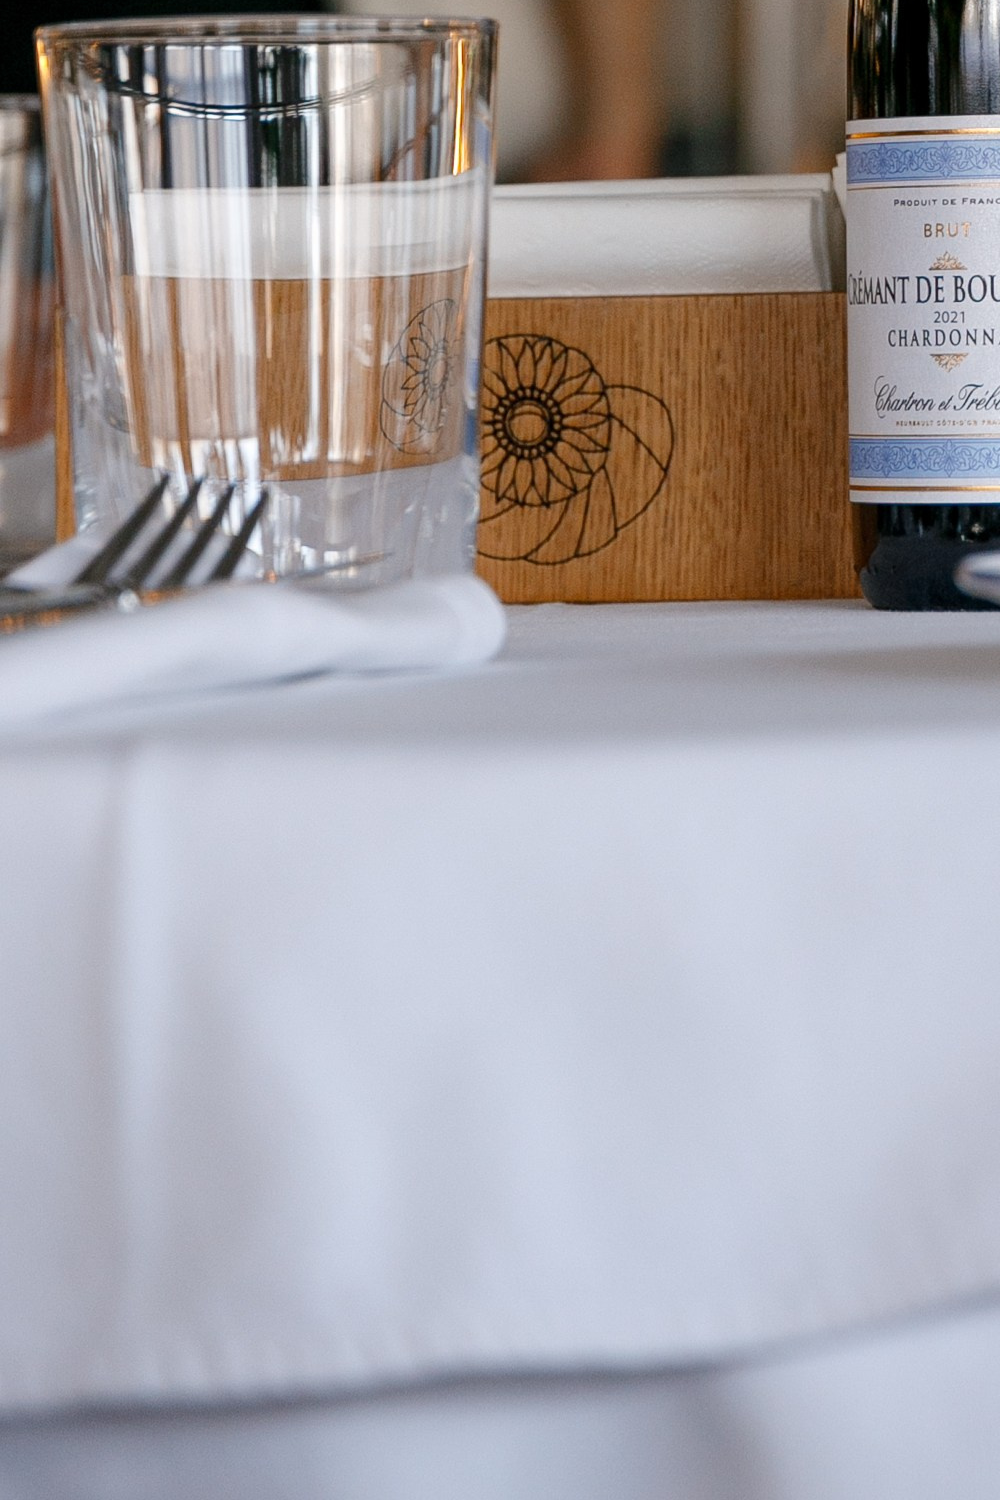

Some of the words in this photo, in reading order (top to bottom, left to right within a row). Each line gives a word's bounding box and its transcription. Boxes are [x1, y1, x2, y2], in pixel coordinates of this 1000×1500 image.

[893, 198, 938, 207] PRODUIT
[942, 198, 956, 206] DE
[923, 222, 972, 238] BRUT
[848, 270, 910, 306] CRÉMANT
[915, 275, 945, 304] DE
[933, 311, 966, 324] 2021
[874, 375, 936, 419] Chartron
[937, 395, 954, 411] et
